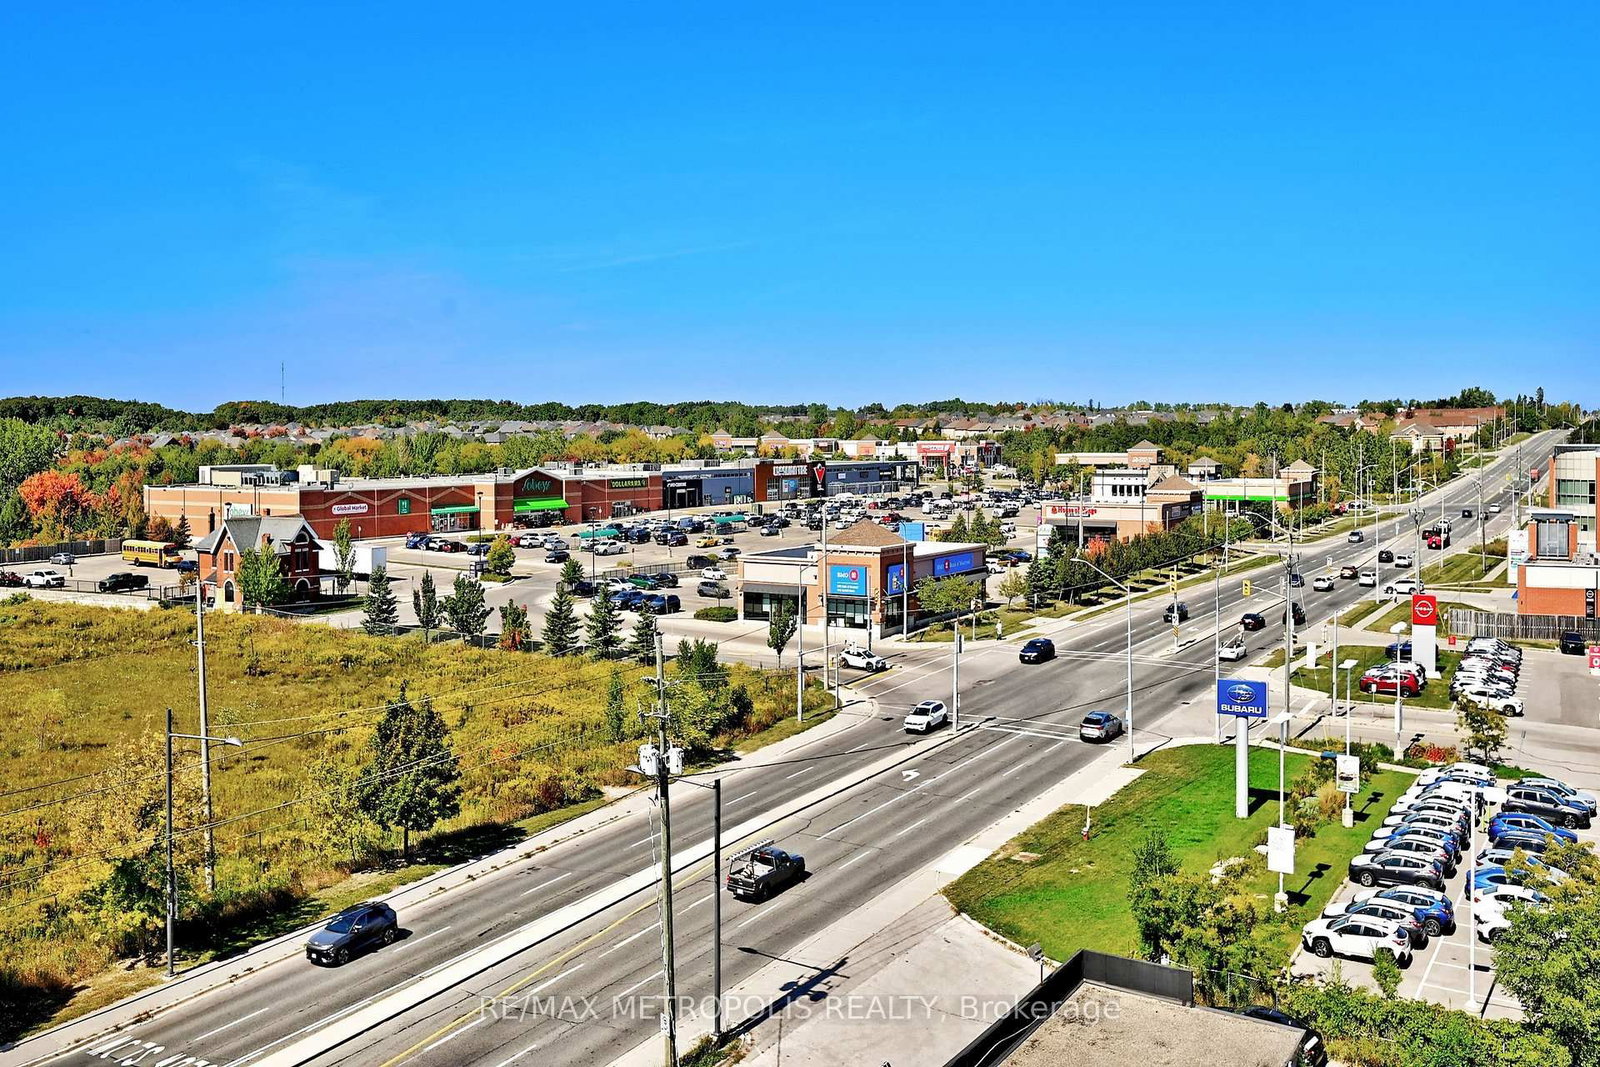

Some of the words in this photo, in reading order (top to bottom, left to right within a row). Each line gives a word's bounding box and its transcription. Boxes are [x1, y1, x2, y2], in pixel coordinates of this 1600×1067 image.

[336, 505, 352, 513] Global
[352, 504, 367, 512] Market
[1221, 704, 1262, 714] SUBARU
